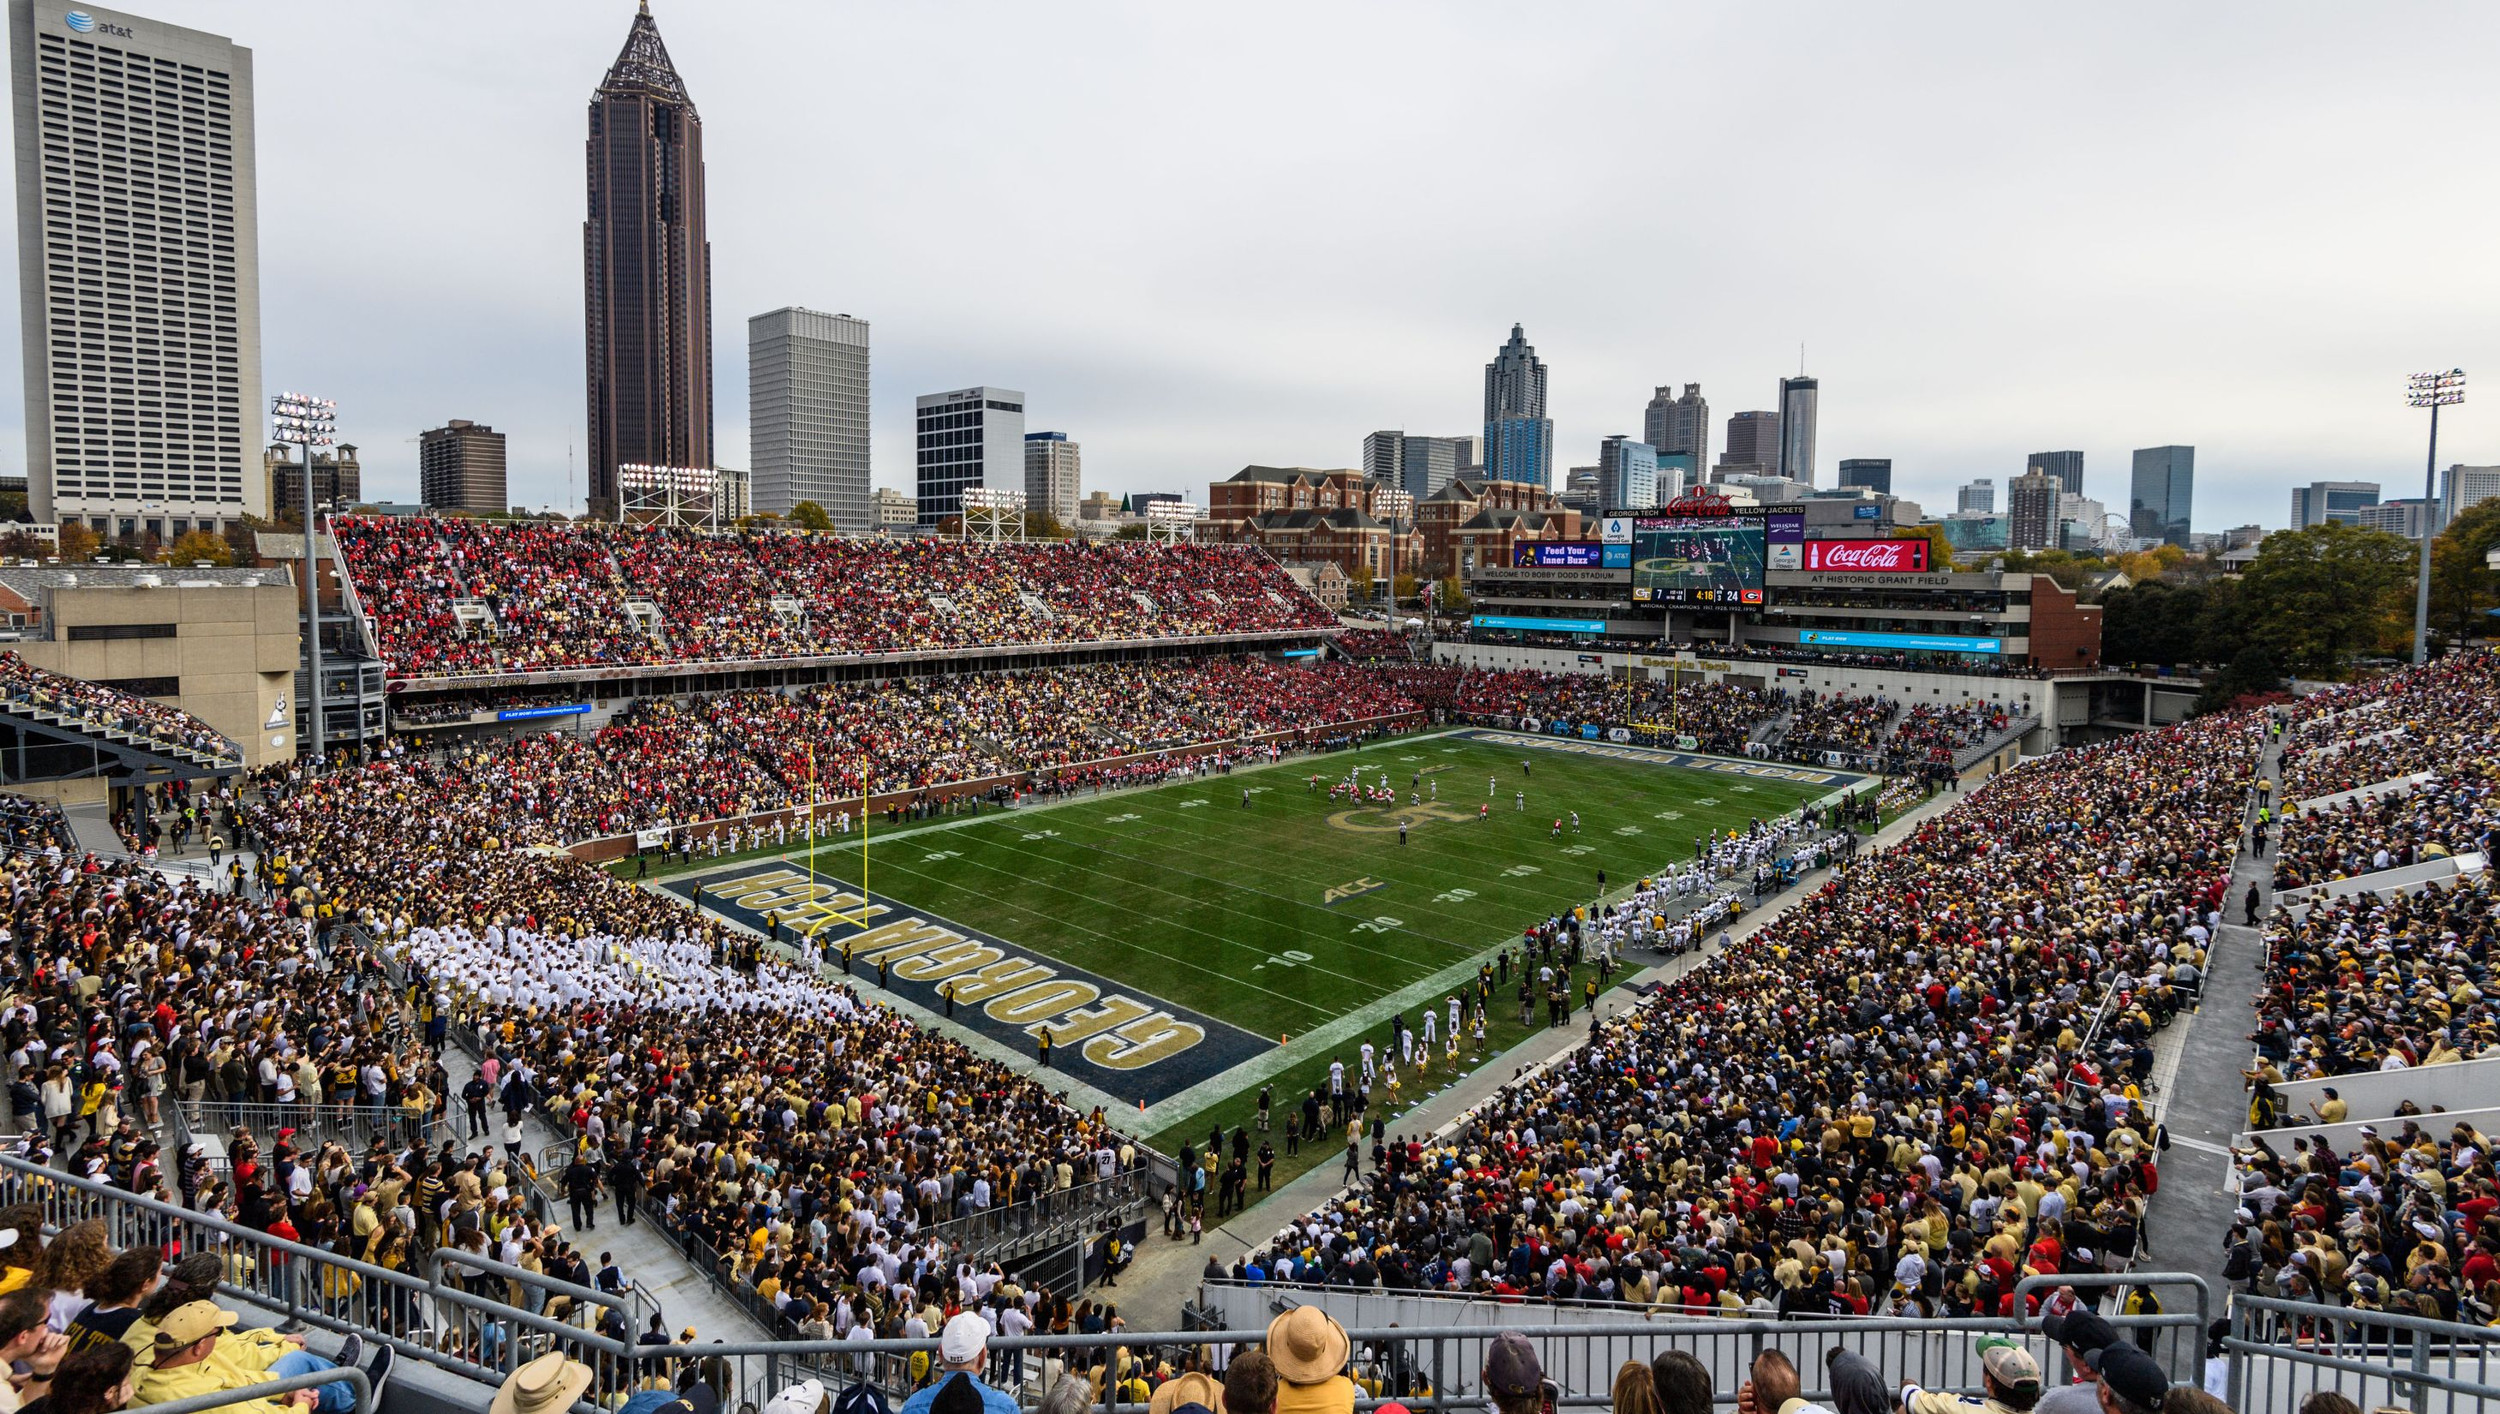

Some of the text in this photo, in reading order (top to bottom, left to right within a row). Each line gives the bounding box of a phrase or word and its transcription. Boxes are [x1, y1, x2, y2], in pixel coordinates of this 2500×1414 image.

[98, 22, 133, 39] at&t
[1545, 546, 1564, 555] Feed
[1566, 546, 1586, 555] Your
[1826, 544, 1904, 567] Coca-Cola
[1543, 556, 1588, 564] Inner Buzz
[1827, 576, 1875, 584] HISTORIC
[1878, 576, 1915, 584] GRANT
[1918, 577, 1949, 585] FIELD
[1657, 589, 1662, 599] 7
[1696, 590, 1713, 600] 4:16
[1727, 590, 1738, 602] 24
[1642, 656, 1731, 672] Georgia Tech
[448, 678, 530, 690] HALL OF FAME
[1472, 733, 1836, 784] GEORGIA TECH
[1324, 876, 1385, 904] ACC
[1436, 888, 1478, 902] 30
[1358, 916, 1404, 934] 20
[1266, 950, 1314, 968] 10
[701, 869, 1206, 1071] GEORGIA TECH
[1102, 1156, 1110, 1164] 27
